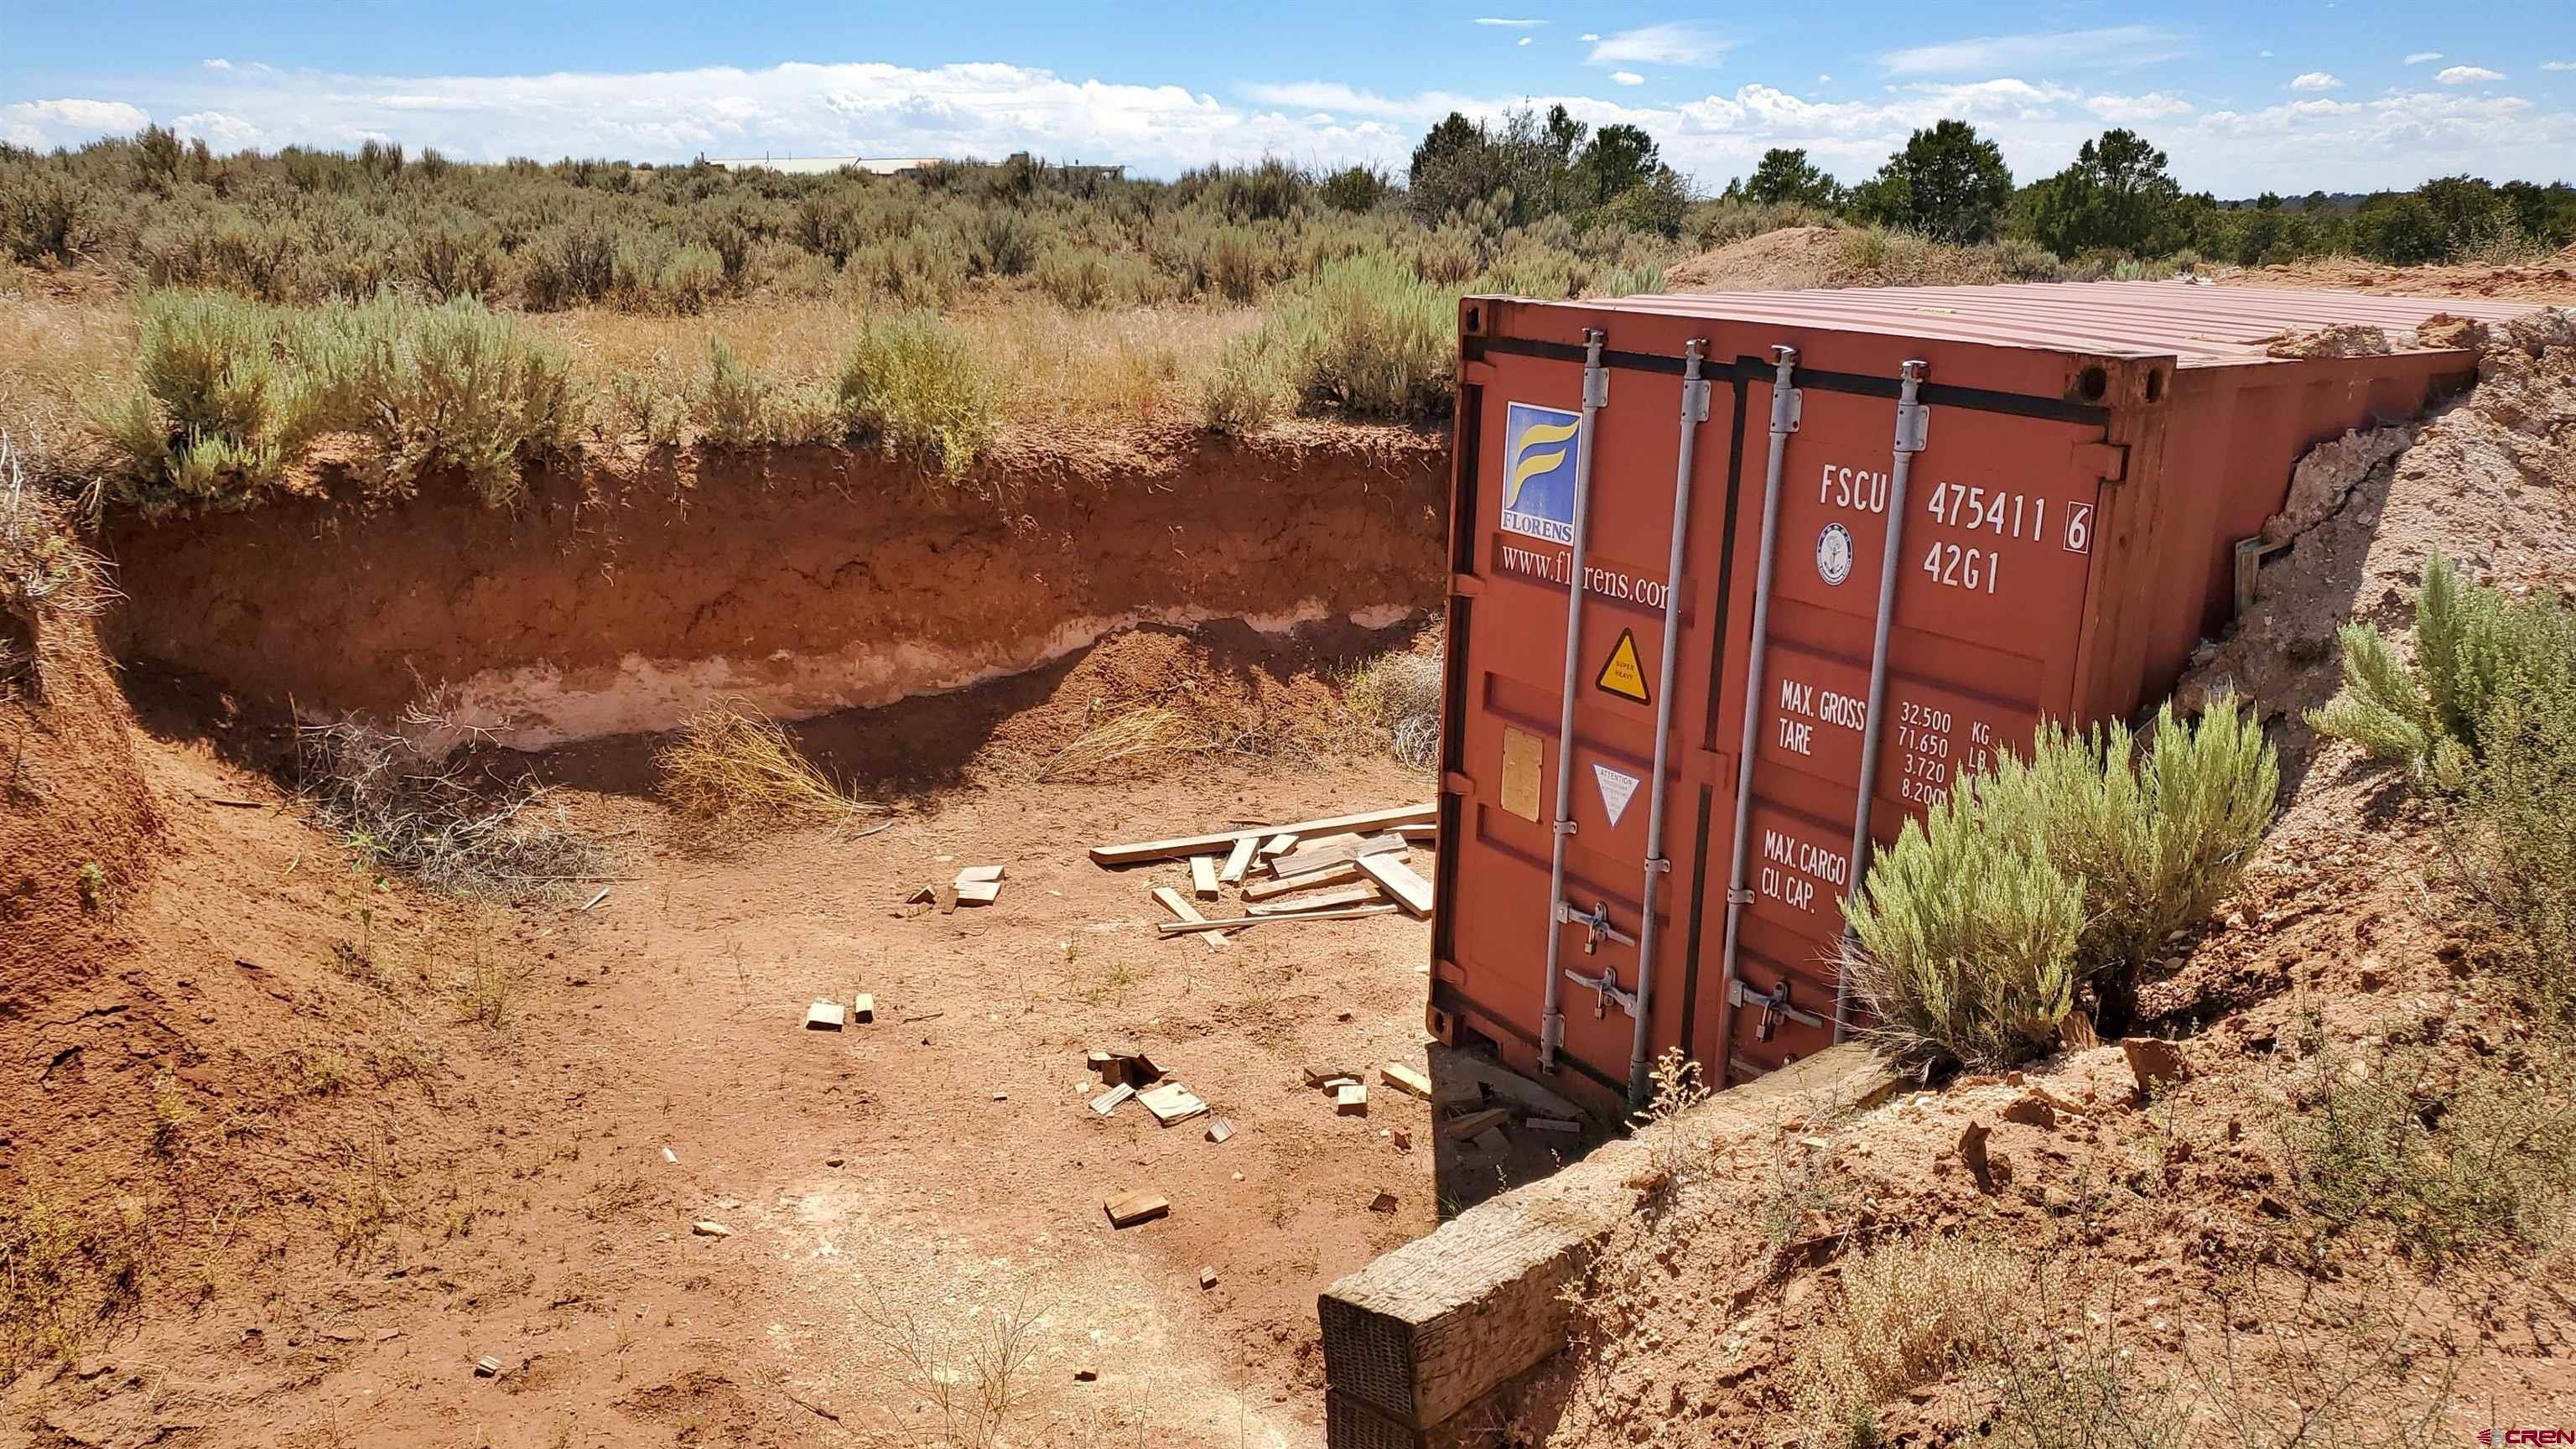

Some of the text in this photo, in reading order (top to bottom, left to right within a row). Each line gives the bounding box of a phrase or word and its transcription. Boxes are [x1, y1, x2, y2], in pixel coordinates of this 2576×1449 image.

[1503, 512, 1572, 543] FLORENS
[1820, 464, 2089, 549] FSCU 475411 6
[1503, 545, 1682, 615] www.flrens.co
[1923, 542, 1999, 594] 42G1
[1781, 679, 1815, 718] MAX.
[1820, 691, 1866, 731] GROSS
[1971, 721, 1991, 745] KG
[1779, 718, 1813, 756] TARE
[1967, 746, 1987, 771] LB
[1600, 769, 1633, 786] ATTENTION
[1764, 829, 1846, 886] MAX. CARGO
[1762, 867, 1815, 914] CU. CAP.
